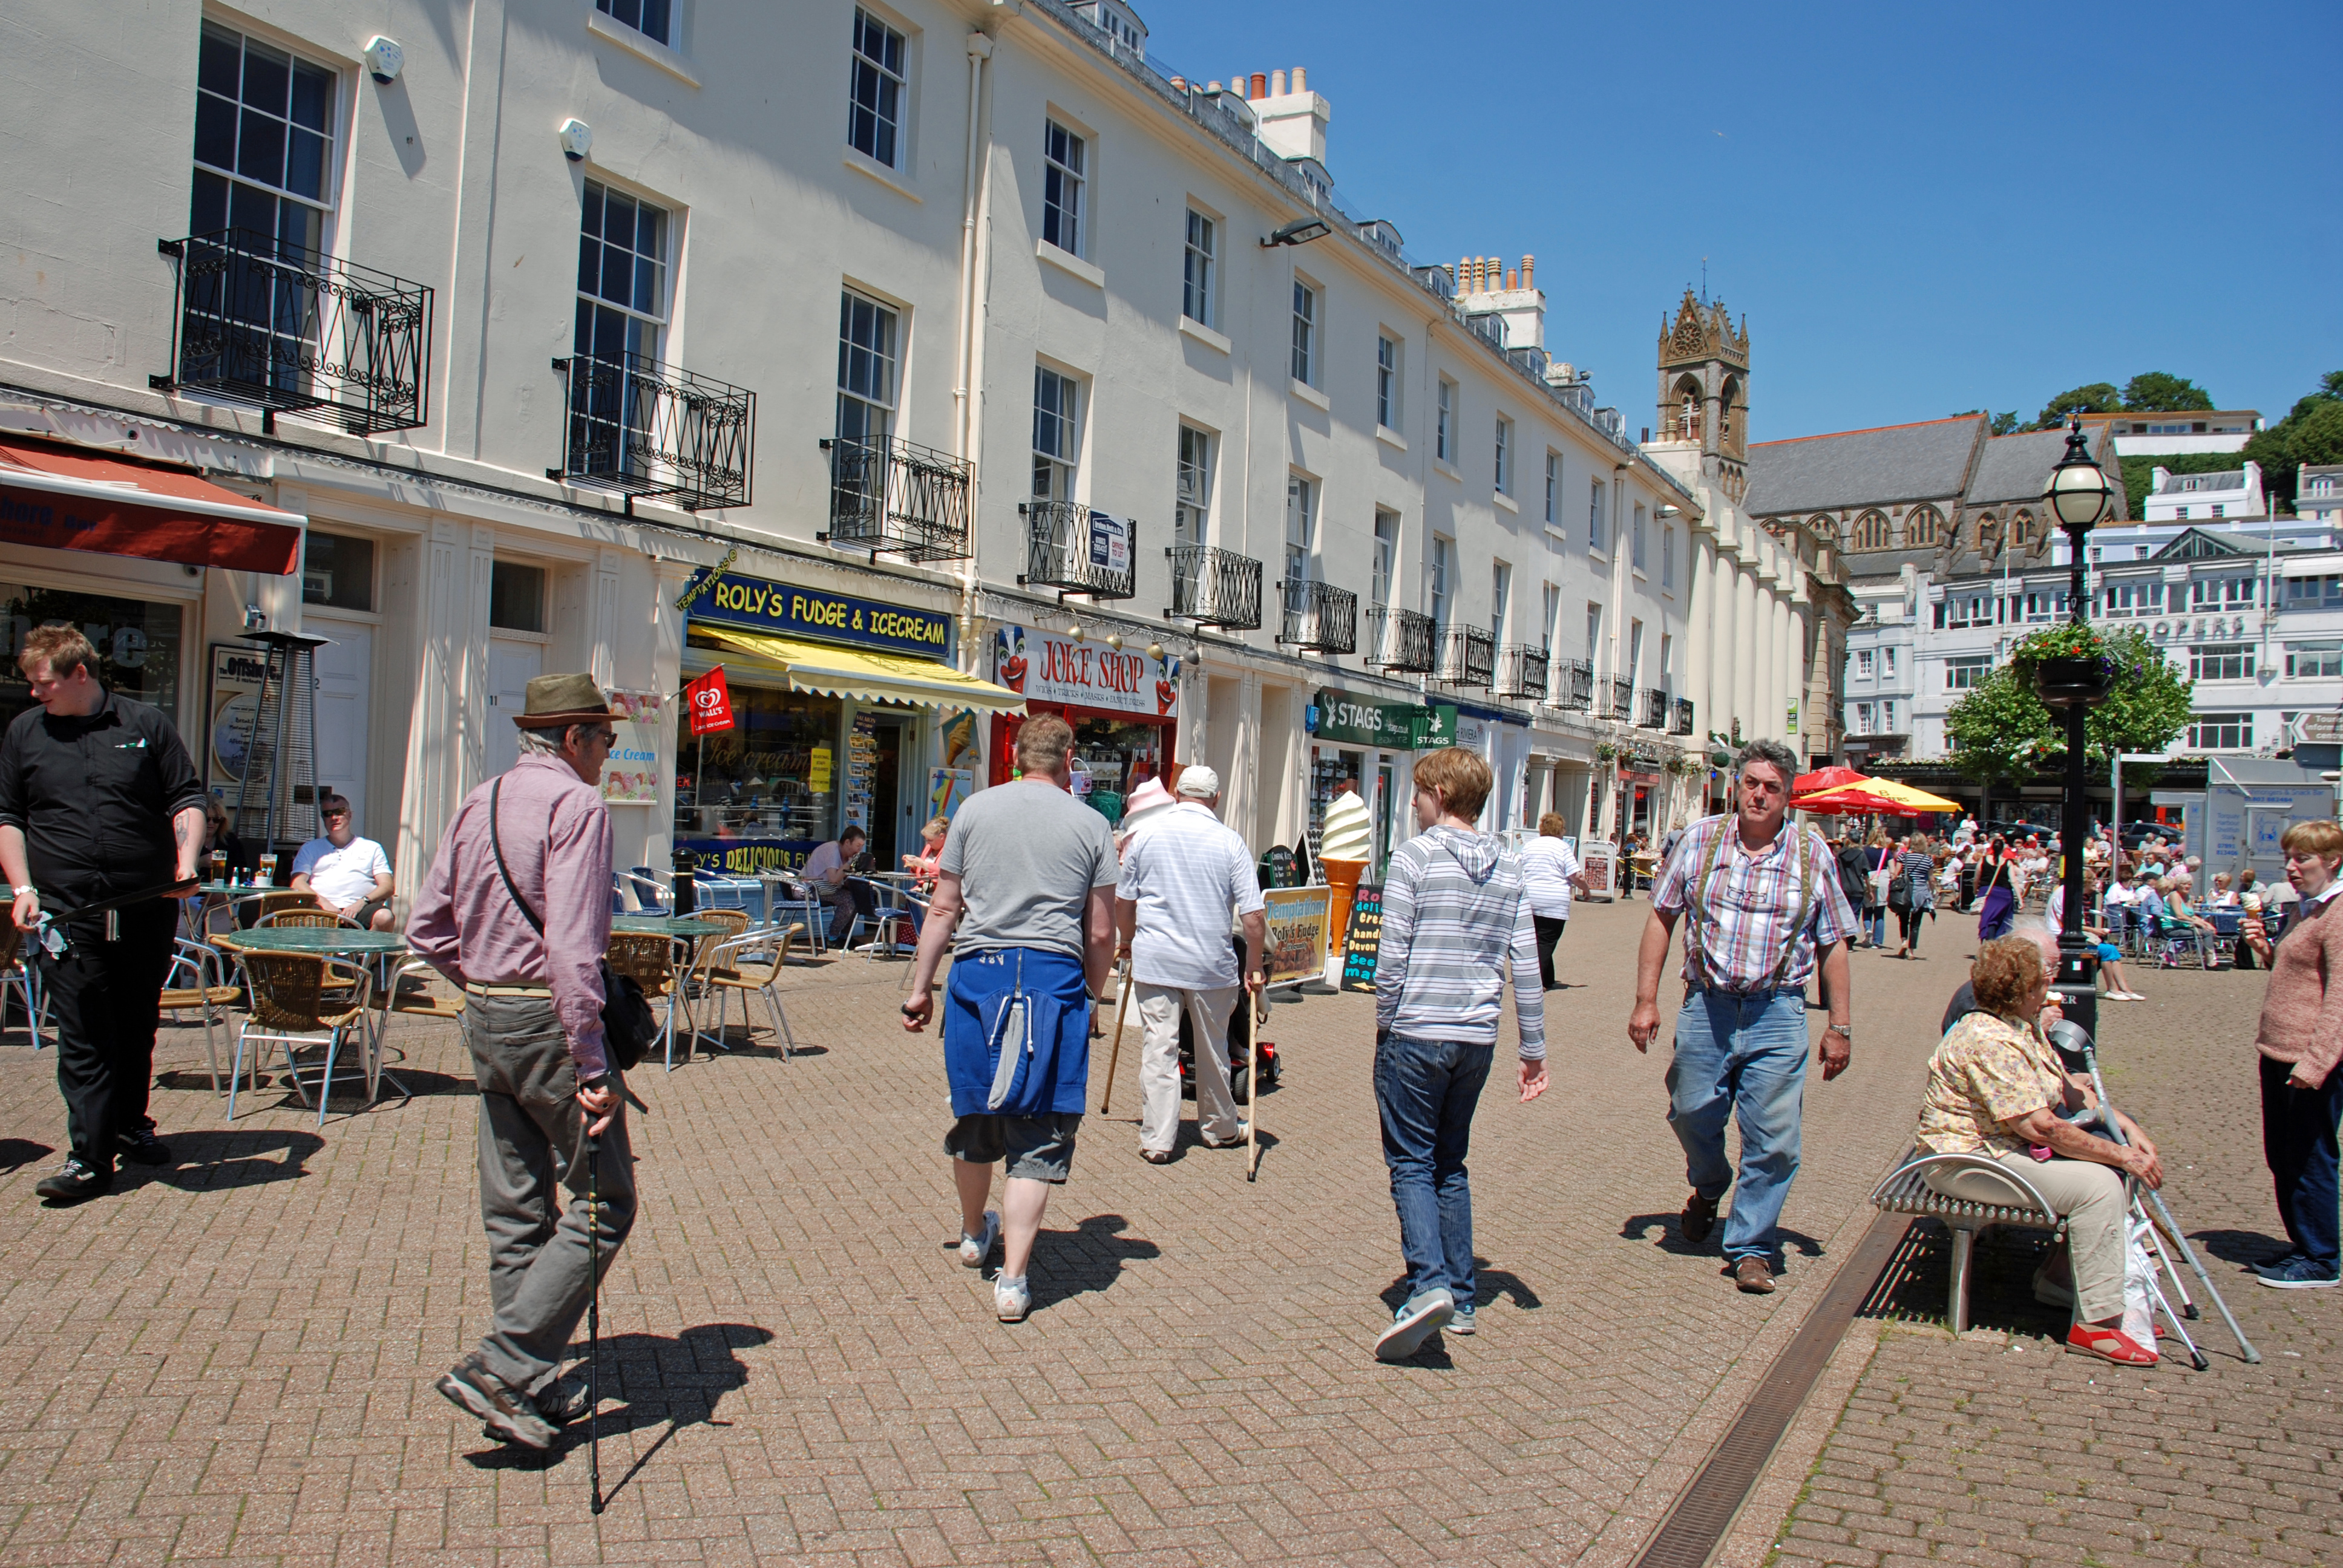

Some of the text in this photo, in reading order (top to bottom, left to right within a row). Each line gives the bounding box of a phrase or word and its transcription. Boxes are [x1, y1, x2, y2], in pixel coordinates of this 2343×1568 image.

[675, 558, 730, 611] TEMPTATIONS
[716, 581, 945, 645] ROLY'S FUDGE & ICECREAM
[1040, 641, 1144, 693] JOKE SHOP
[1035, 685, 1145, 707] WIGS TRICKS MASKS FANCY DRESS
[698, 707, 723, 718] WALL'S
[1338, 702, 1382, 731] STAGS
[1417, 736, 1449, 745] STAGS
[1460, 727, 1478, 740] RIVIERA
[609, 748, 655, 762] ce Cream
[726, 846, 790, 874] DELICIOUS
[1357, 889, 1383, 902] Ro
[1266, 895, 1326, 923] Temptations
[1297, 923, 1319, 940] Fudge
[1349, 940, 1377, 951] Devon
[1349, 953, 1375, 967] See
